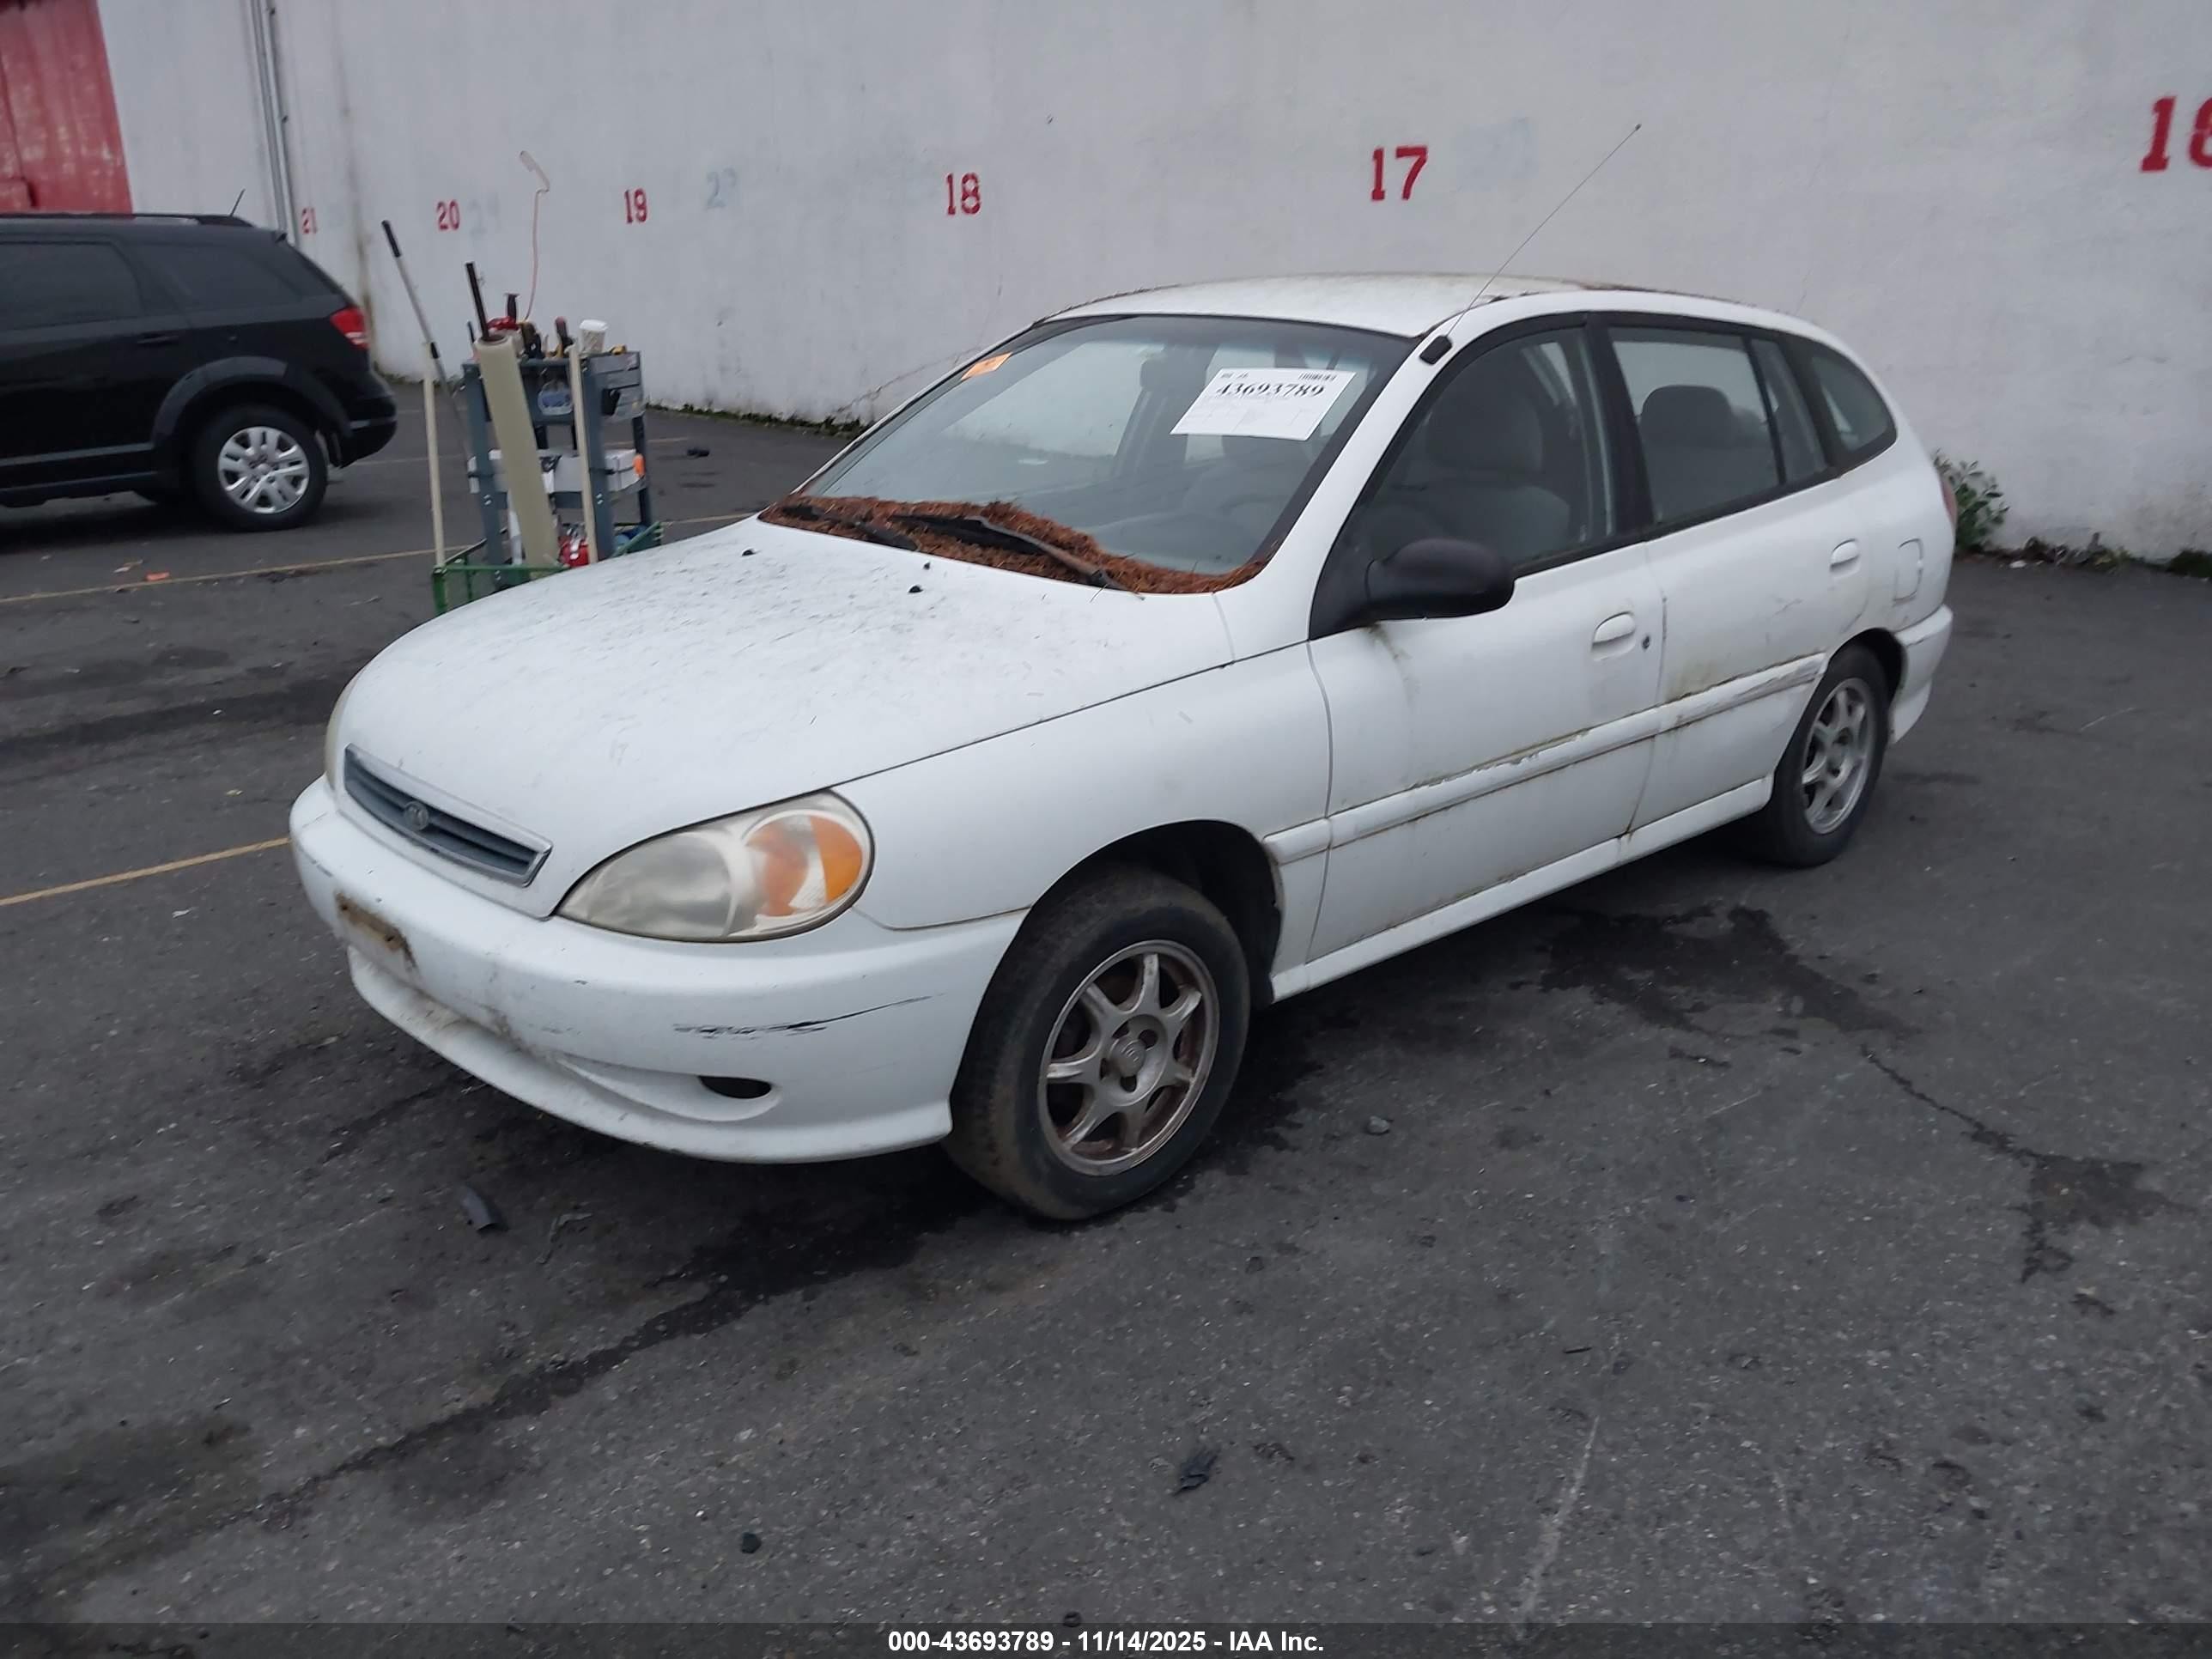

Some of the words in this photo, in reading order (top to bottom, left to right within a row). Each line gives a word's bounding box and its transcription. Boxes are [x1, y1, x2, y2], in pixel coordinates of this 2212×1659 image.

[1370, 143, 1430, 204] 17
[623, 188, 649, 224] 19
[945, 172, 982, 218] 18
[301, 207, 318, 234] 21
[436, 199, 460, 231] 20
[1216, 382, 1325, 398] 43693789
